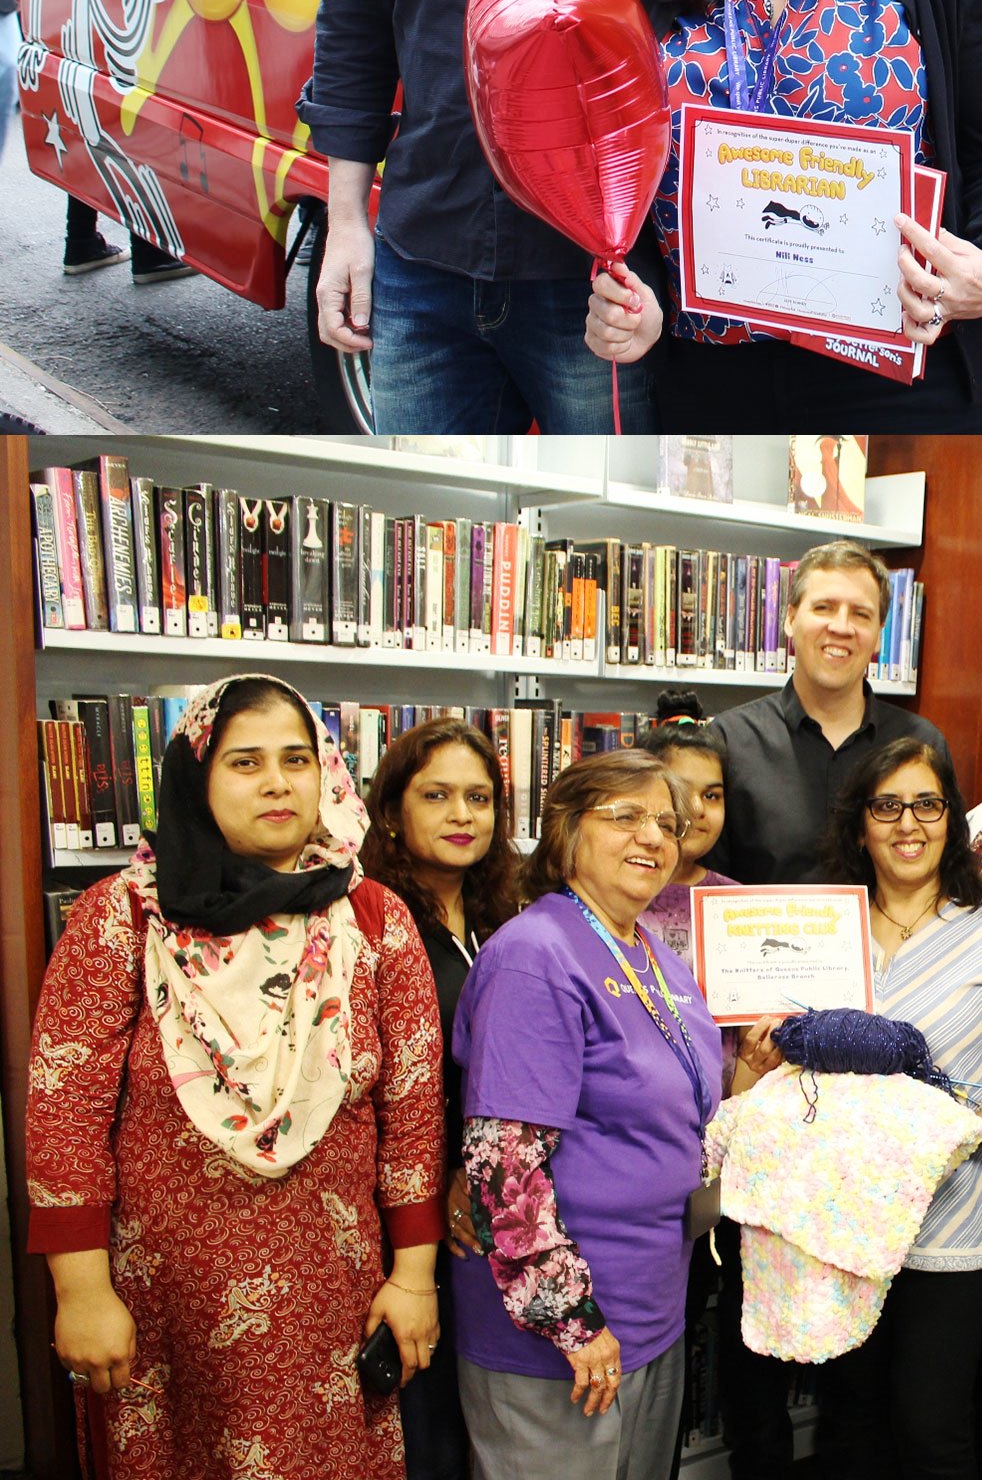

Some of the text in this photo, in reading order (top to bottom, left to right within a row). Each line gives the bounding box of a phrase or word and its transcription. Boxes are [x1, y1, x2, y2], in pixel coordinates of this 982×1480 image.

[730, 28, 738, 50] PUBLIC
[732, 51, 740, 76] LIBRARY
[756, 54, 771, 103] PUBLIC LIBRARY
[718, 143, 876, 190] Awesome Friendly
[741, 168, 847, 200] LIBRARIAN
[756, 236, 783, 245] certificate
[789, 242, 810, 250] proudly
[810, 246, 838, 254] presented
[776, 251, 814, 264] Nili Ness
[826, 338, 880, 368] JOURNAL
[110, 494, 133, 595] ARCHENEMIES
[40, 525, 59, 604] APOTHECARY
[612, 606, 620, 626] BEC
[140, 758, 153, 791] ttfn
[540, 736, 550, 785] SPLINTERED
[723, 902, 842, 924] Awesome Friendly
[727, 922, 838, 936] KNITTING CLUB
